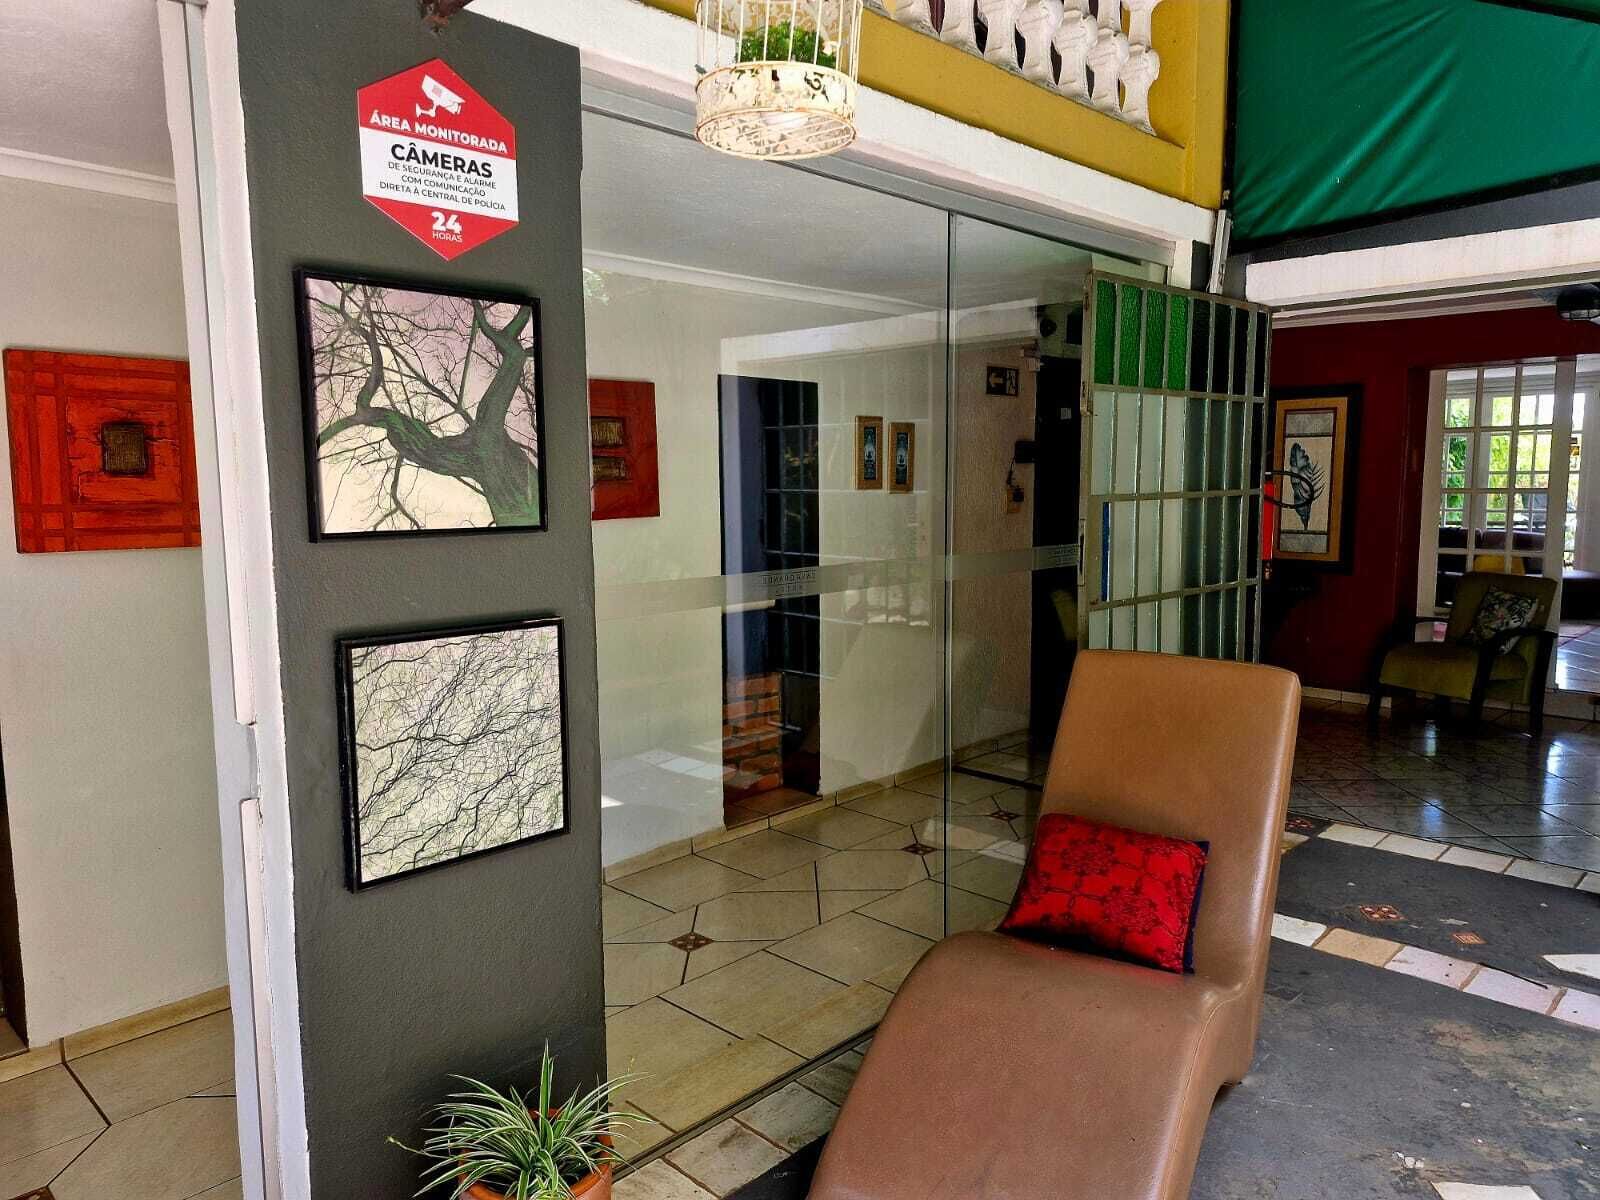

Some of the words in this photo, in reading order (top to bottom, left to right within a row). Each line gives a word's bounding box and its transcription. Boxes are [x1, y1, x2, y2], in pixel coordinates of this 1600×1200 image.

[370, 110, 411, 132] ÁREA
[414, 121, 507, 153] MONITORADA
[391, 142, 493, 178] CÂMERAS
[388, 161, 400, 170] DE
[403, 163, 455, 181] SEGURANÇA
[457, 174, 462, 182] E
[464, 176, 496, 189] ALARME
[401, 175, 421, 185] COM
[424, 177, 486, 197] COMUNICAÇÃO
[379, 181, 411, 193] DIRETA
[422, 188, 460, 203] CENTRAL
[462, 196, 472, 205] DE
[475, 198, 506, 211] POLÍCIA
[431, 211, 462, 234] 24
[432, 231, 463, 243] HORAS
